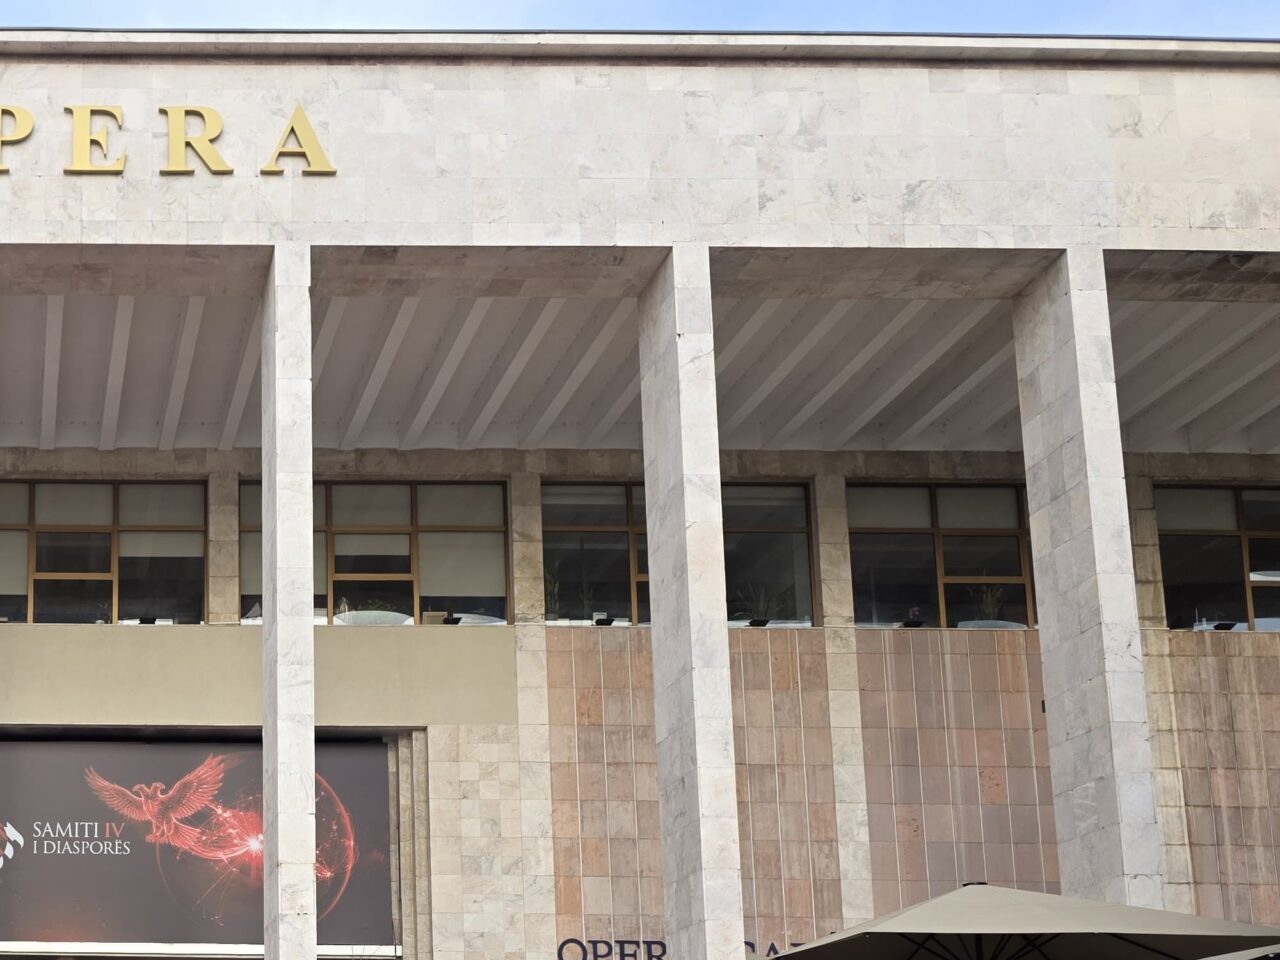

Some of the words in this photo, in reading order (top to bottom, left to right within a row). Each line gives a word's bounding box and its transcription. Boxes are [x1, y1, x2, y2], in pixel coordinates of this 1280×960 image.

[32, 821, 99, 838] SAMITI
[104, 822, 126, 838] IV
[32, 840, 38, 854] I
[43, 839, 131, 855] DIASPORËS
